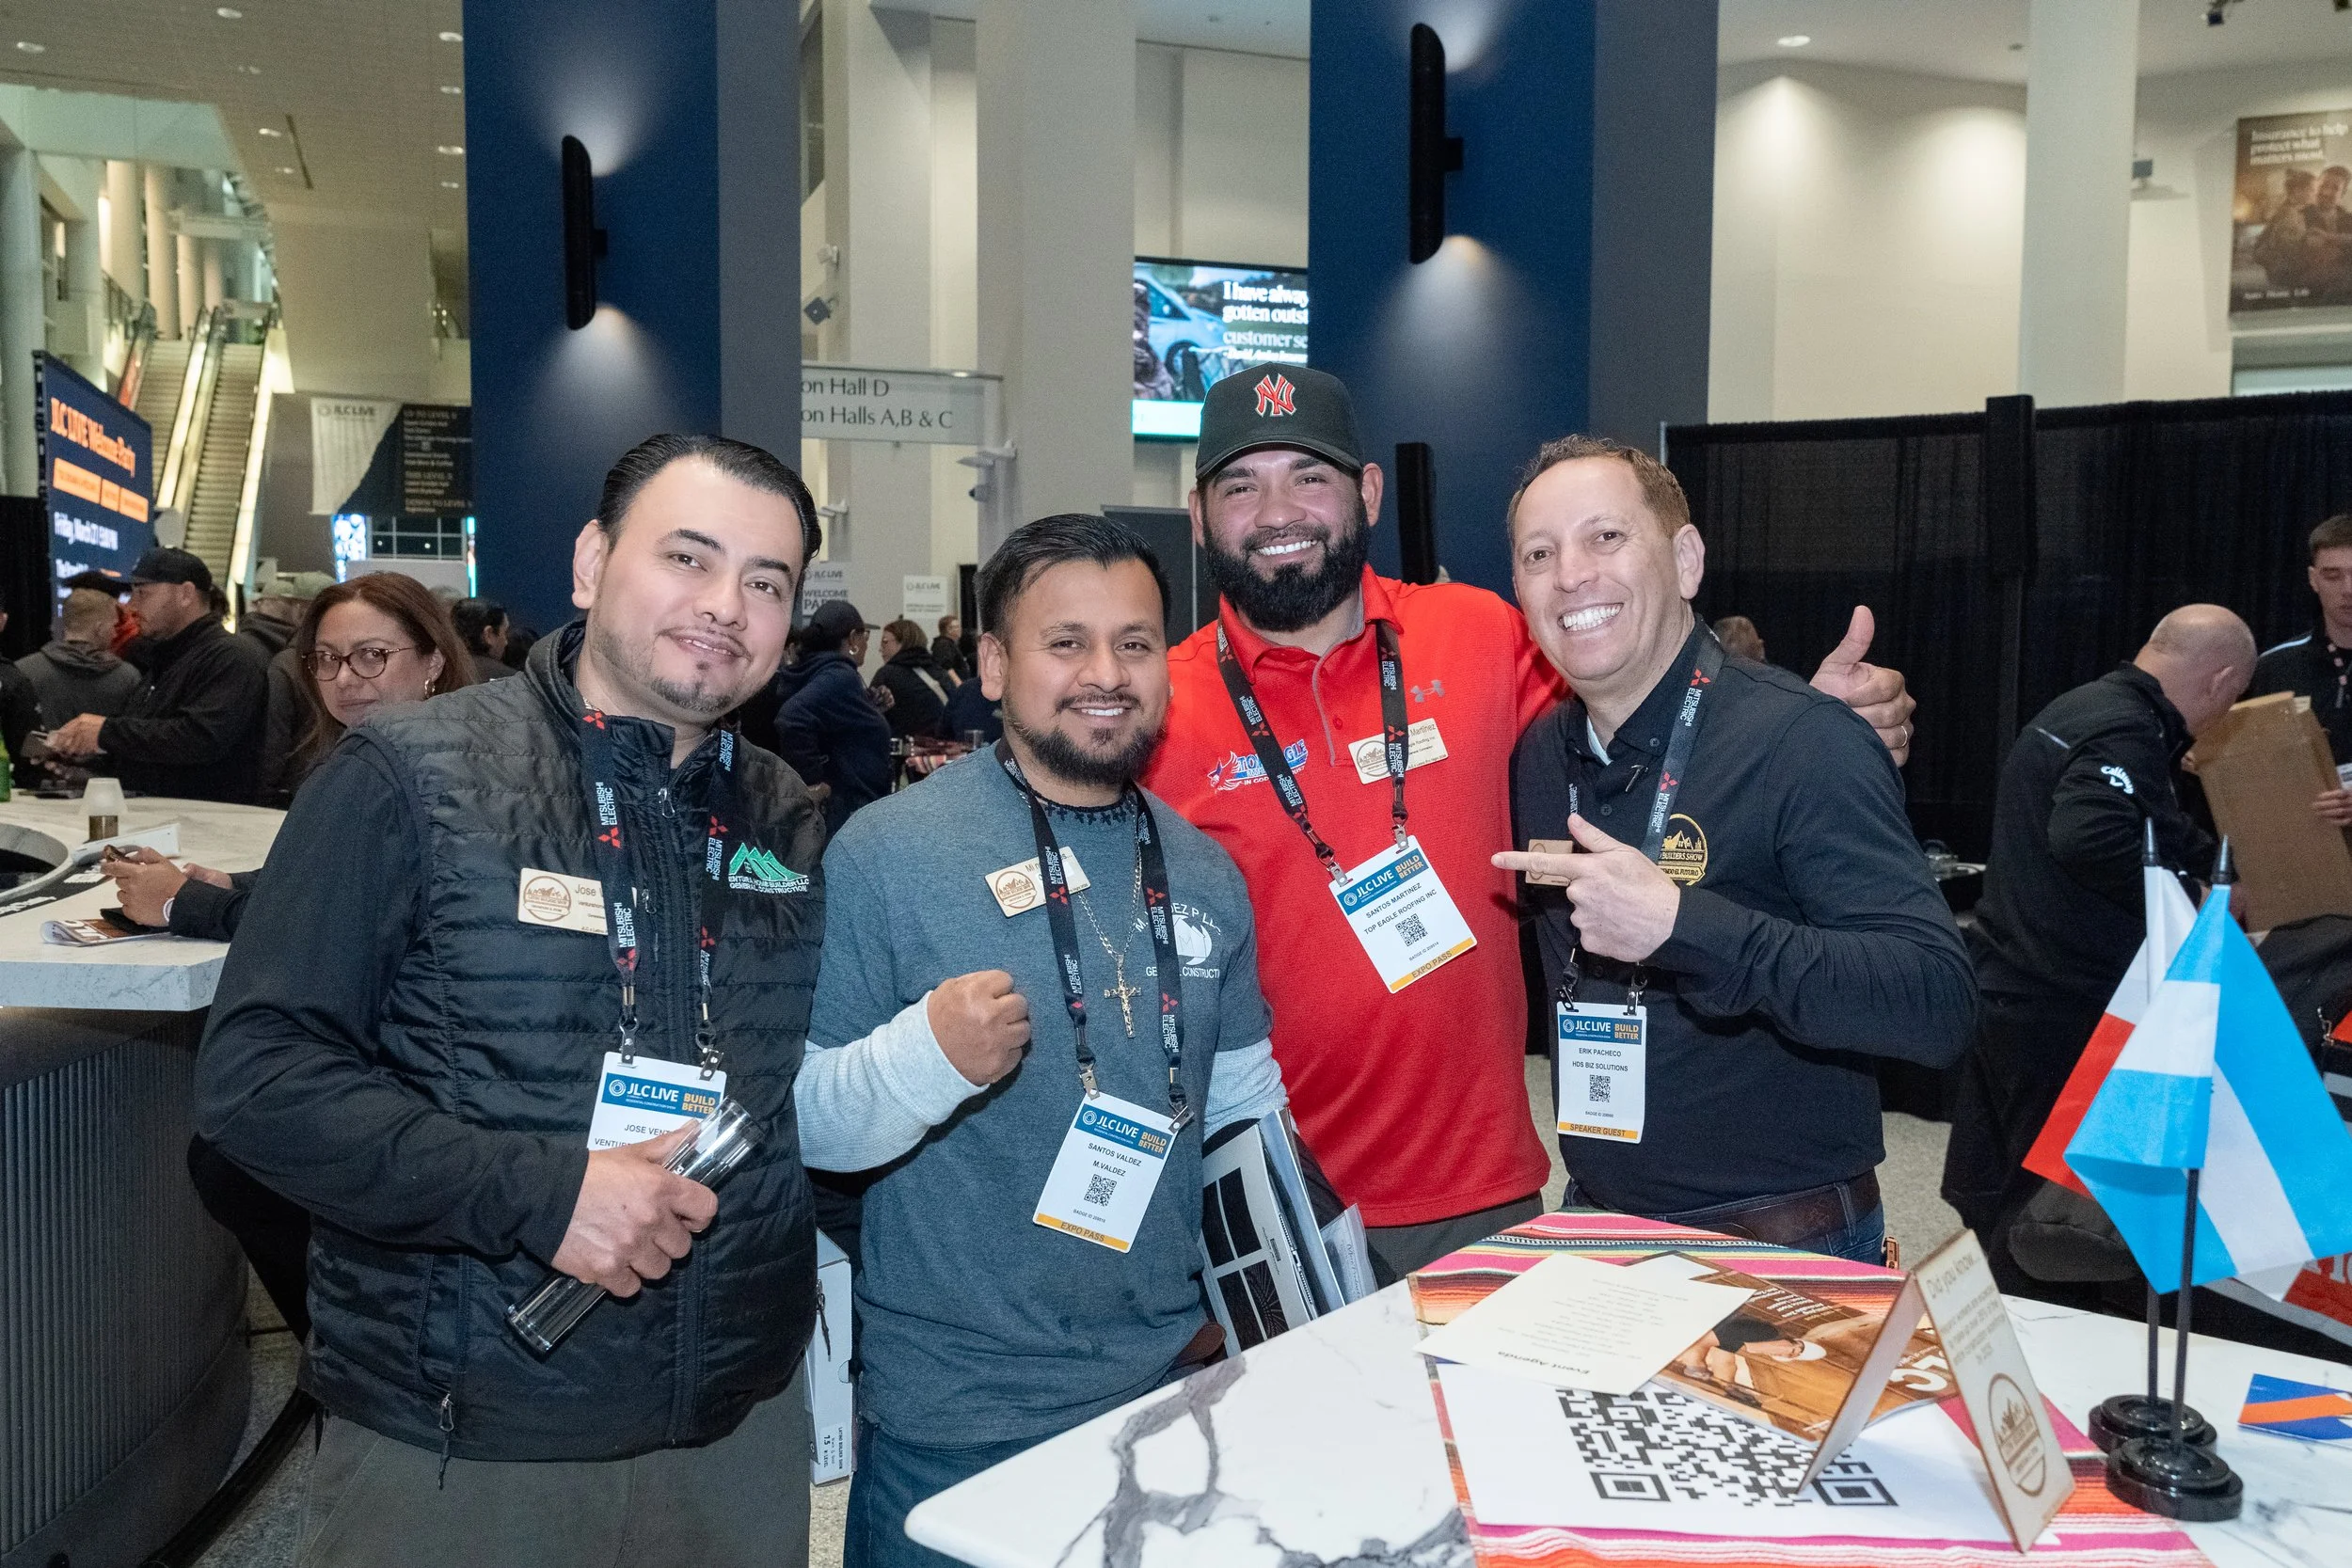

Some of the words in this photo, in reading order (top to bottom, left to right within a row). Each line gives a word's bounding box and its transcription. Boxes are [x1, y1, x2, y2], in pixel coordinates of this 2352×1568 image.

[1223, 281, 1232, 300] I
[1232, 282, 1268, 302] have
[1222, 305, 1269, 323] gotten
[1224, 331, 1291, 347] customer
[830, 377, 866, 397] Hall
[873, 379, 889, 397] D
[1254, 373, 1296, 417] NY
[831, 405, 876, 425] Halls
[918, 410, 933, 428] &
[938, 411, 953, 429] C
[1680, 687, 1695, 721] ELECTRIC
[1685, 689, 1703, 727] MITSUBISHI
[1409, 723, 1437, 736] Martinez
[1389, 743, 1397, 772] ELECTRIC
[1394, 742, 1405, 778] MITSUBISHI
[596, 782, 610, 825] MITSUBISHI
[605, 787, 617, 825] ELECTRIC
[706, 836, 716, 873] ELECTRIC
[712, 839, 723, 880] MITSUBISHI
[1044, 846, 1057, 884] MITSUBISHI
[1395, 854, 1420, 873] BUILD
[1686, 852, 1704, 862] SHOW
[1051, 851, 1064, 884] ELECTRIC
[1398, 861, 1423, 879] BETTER
[1373, 869, 1394, 888] LIVE
[574, 883, 596, 897] Jose
[1366, 901, 1391, 919] SANTOS
[1391, 882, 1422, 904] MARTINEZ
[1364, 925, 1376, 935] TOP
[1377, 912, 1398, 928] EAGLE
[1398, 897, 1426, 918] ROOFING
[1425, 888, 1438, 901] INC
[613, 902, 628, 948] MITSUBISHI
[623, 907, 636, 947] ELECTRIC
[1151, 906, 1163, 940] ELECTRIC
[1156, 906, 1168, 944] MITSUBISHI
[1183, 966, 1220, 978] CONSTRUCTI
[1411, 961, 1432, 979] EXPO
[1432, 950, 1453, 967] PASS
[1162, 1014, 1171, 1049] ELECTRIC
[1168, 1014, 1179, 1053] MITSUBISHI
[1575, 1020, 1591, 1031] JLC
[1591, 1022, 1611, 1033] LIVE
[1614, 1023, 1639, 1033] BUILD
[1614, 1032, 1639, 1040] BETTER
[1579, 1047, 1593, 1055] ERIK
[1593, 1049, 1622, 1057] PACHECO
[1595, 1063, 1629, 1072] SOLUTIONS
[627, 1083, 650, 1098] JLC
[650, 1087, 679, 1102] LIVE
[684, 1093, 715, 1106] BUILD
[682, 1102, 714, 1115] BETTER
[624, 1124, 646, 1133] JOSE
[1096, 1116, 1117, 1130] JLC
[1116, 1121, 1139, 1139] LIVE
[1569, 1123, 1601, 1135] SPEAKER
[1602, 1126, 1627, 1137] GUEST
[1138, 1139, 1165, 1154] BETTER
[1140, 1132, 1168, 1147] BUILD
[1088, 1143, 1115, 1157] SANTOS
[1116, 1152, 1142, 1167] VALDEZ
[1060, 1222, 1083, 1236] EXPO
[1083, 1229, 1105, 1243] PASS
[1497, 1352, 1549, 1367] Agenda
[1551, 1363, 1590, 1375] Event
